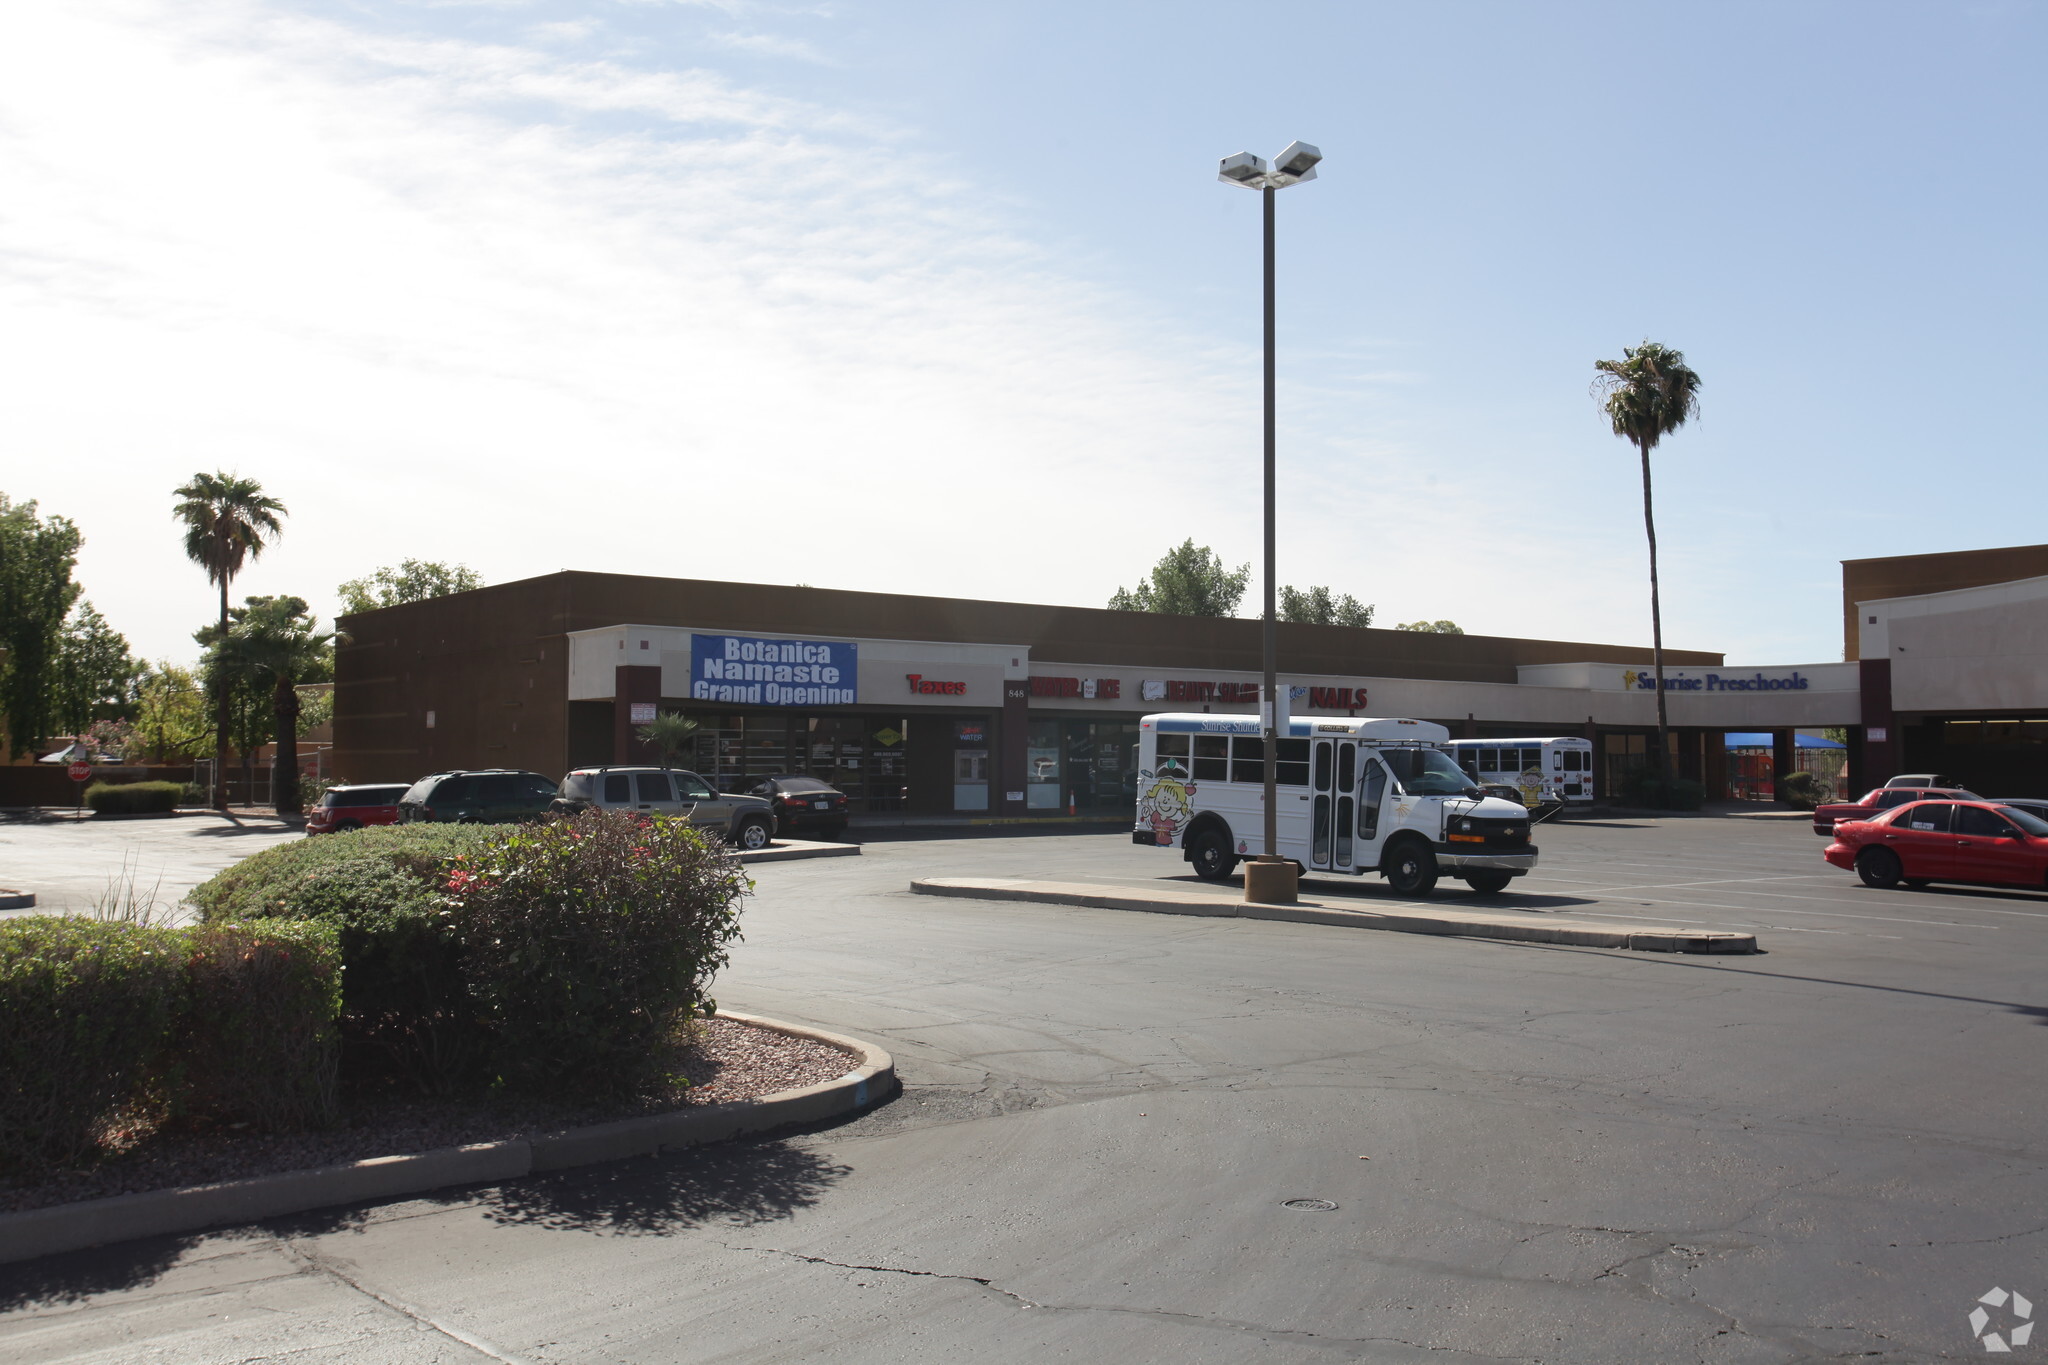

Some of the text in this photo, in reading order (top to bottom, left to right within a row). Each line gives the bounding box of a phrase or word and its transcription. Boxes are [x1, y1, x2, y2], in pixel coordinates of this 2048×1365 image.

[725, 638, 831, 664] Botanica
[704, 658, 840, 684] Namaste
[1706, 672, 1808, 690] Preschools
[694, 680, 854, 705] Grand Opening
[907, 674, 967, 695] Taxes
[1008, 690, 1024, 698] 848
[1029, 677, 1120, 698] WATER ICE
[1168, 681, 1258, 703] BEAUTY SALON
[1309, 687, 1367, 709] NAILS
[1201, 720, 1260, 733] Sunrise Shuttle
[70, 766, 89, 775] STOP
